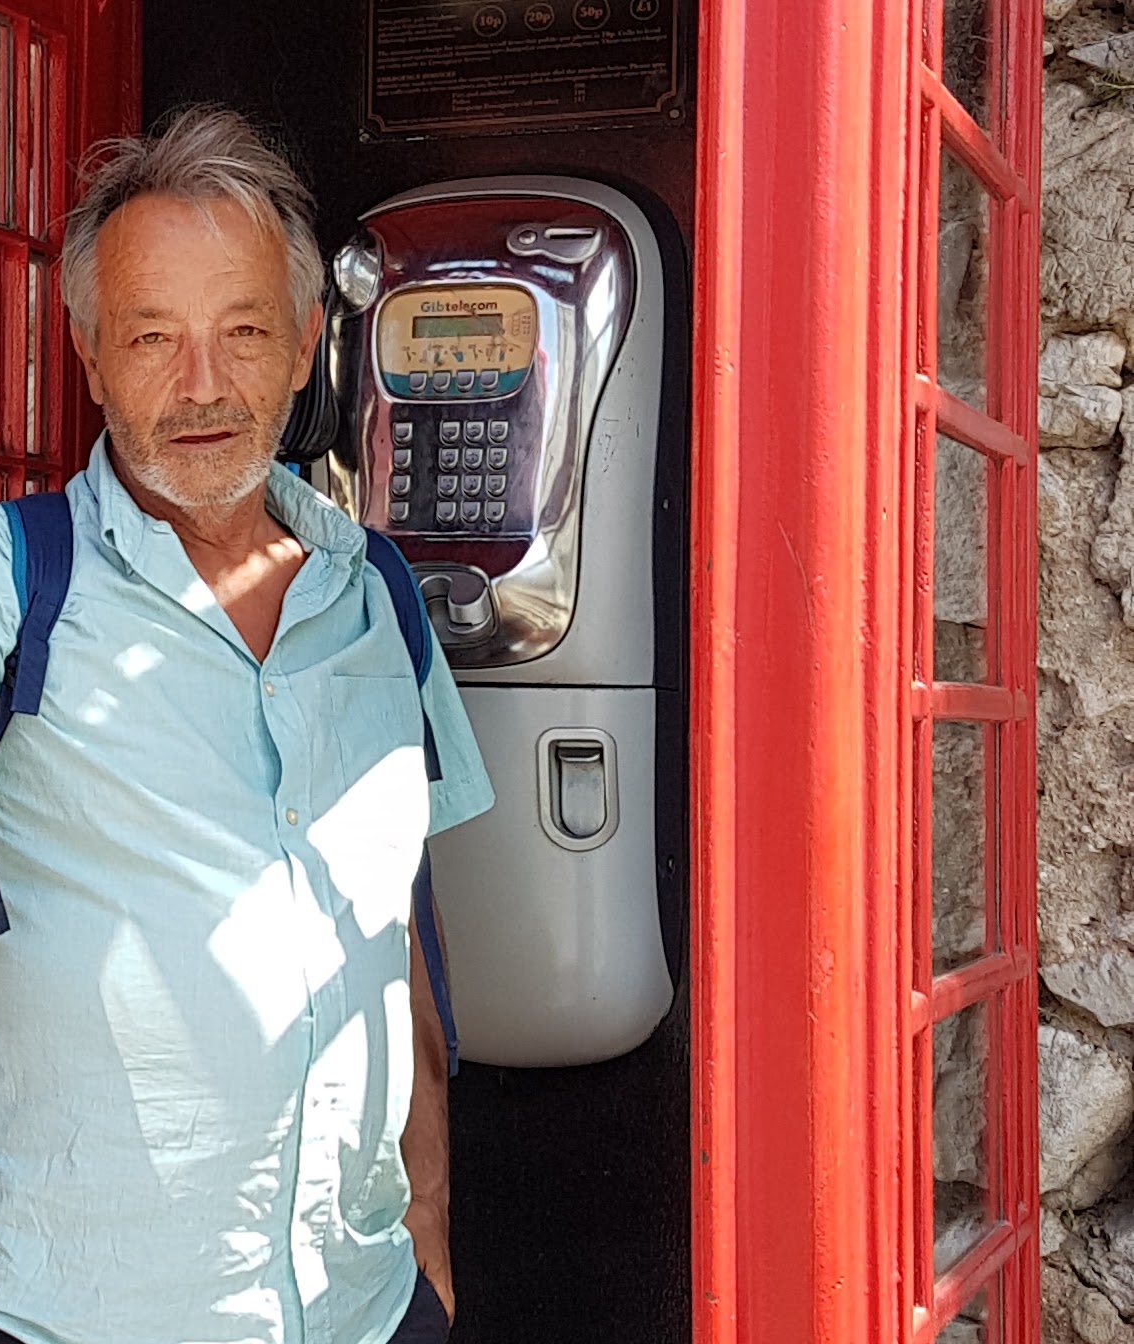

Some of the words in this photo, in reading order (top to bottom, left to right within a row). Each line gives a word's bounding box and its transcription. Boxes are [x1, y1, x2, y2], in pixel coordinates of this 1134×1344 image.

[527, 11, 551, 25] 20p
[579, 6, 604, 19] 50p
[479, 15, 502, 29] 10p
[420, 300, 498, 313] Gibtelecom
